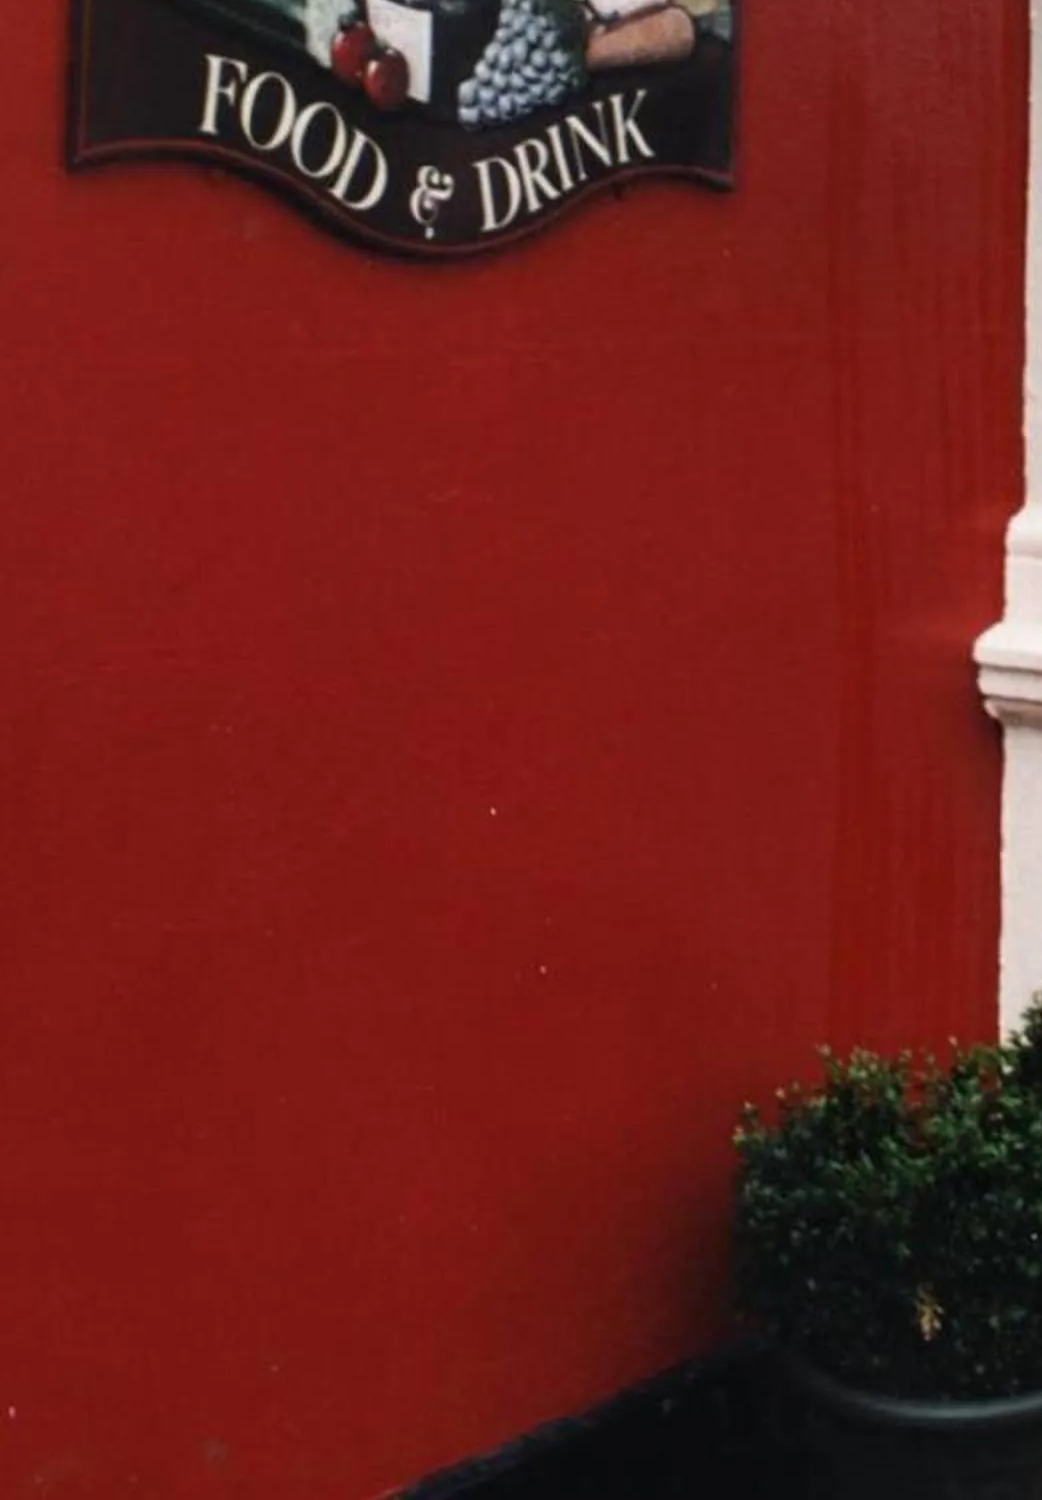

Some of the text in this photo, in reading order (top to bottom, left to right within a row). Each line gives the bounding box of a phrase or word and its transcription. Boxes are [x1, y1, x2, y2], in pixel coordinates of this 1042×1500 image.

[199, 54, 655, 239] FOOD & DRINK
